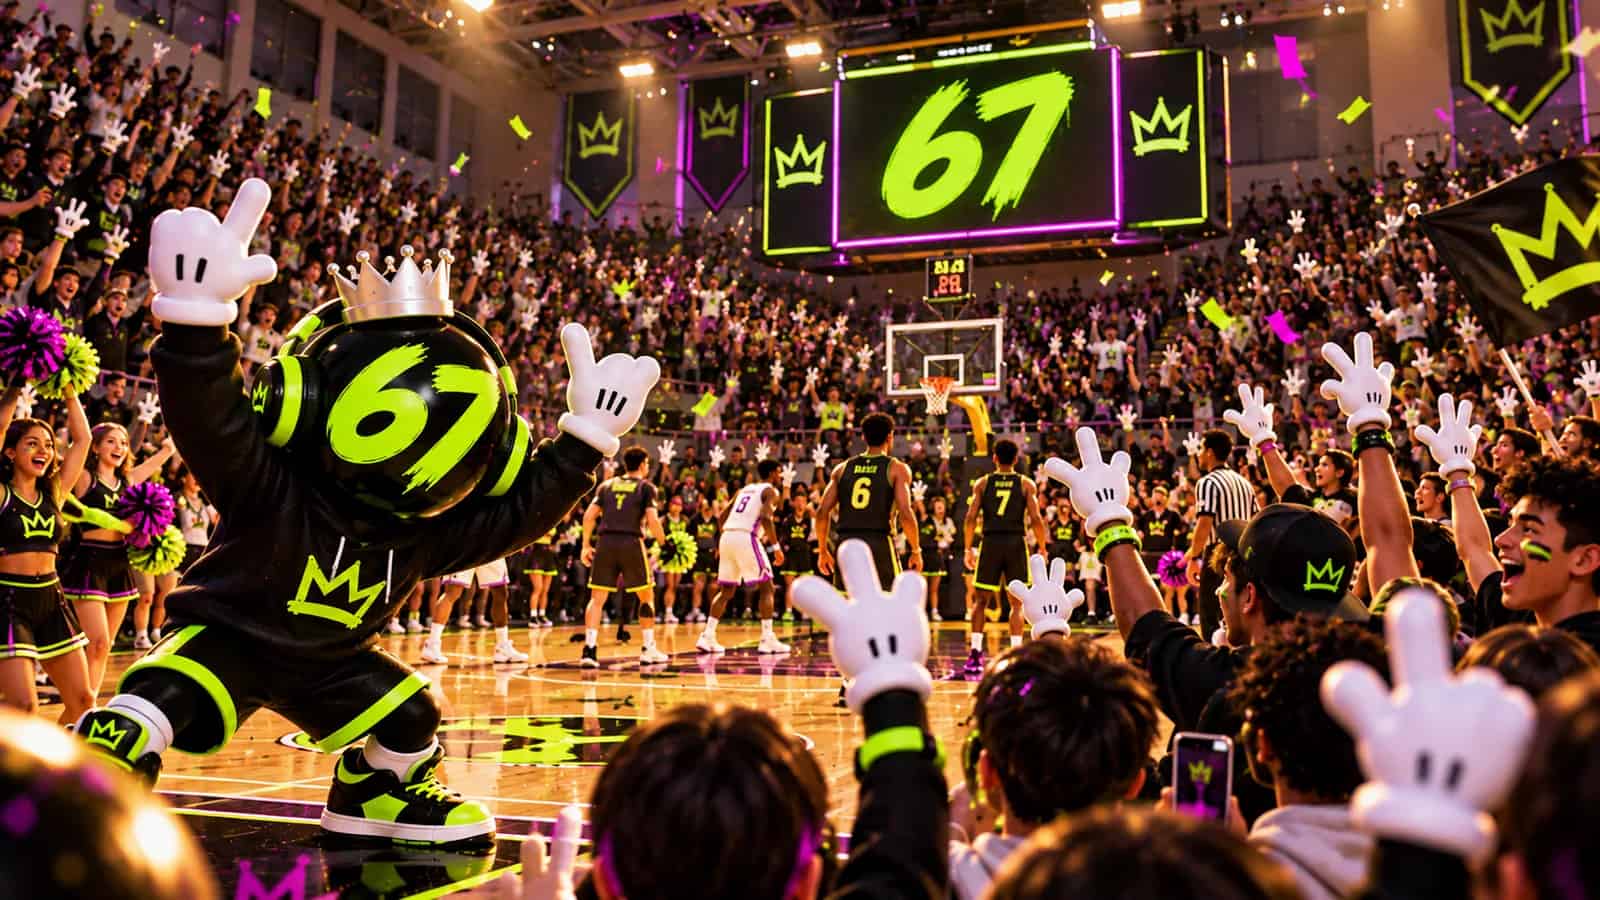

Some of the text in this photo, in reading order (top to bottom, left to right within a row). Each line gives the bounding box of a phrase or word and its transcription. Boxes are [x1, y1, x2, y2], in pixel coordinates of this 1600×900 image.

[881, 71, 1074, 222] 67
[326, 343, 500, 495] 67
[735, 496, 751, 512] 8
[851, 476, 872, 510] 6
[996, 489, 1011, 516] 7
